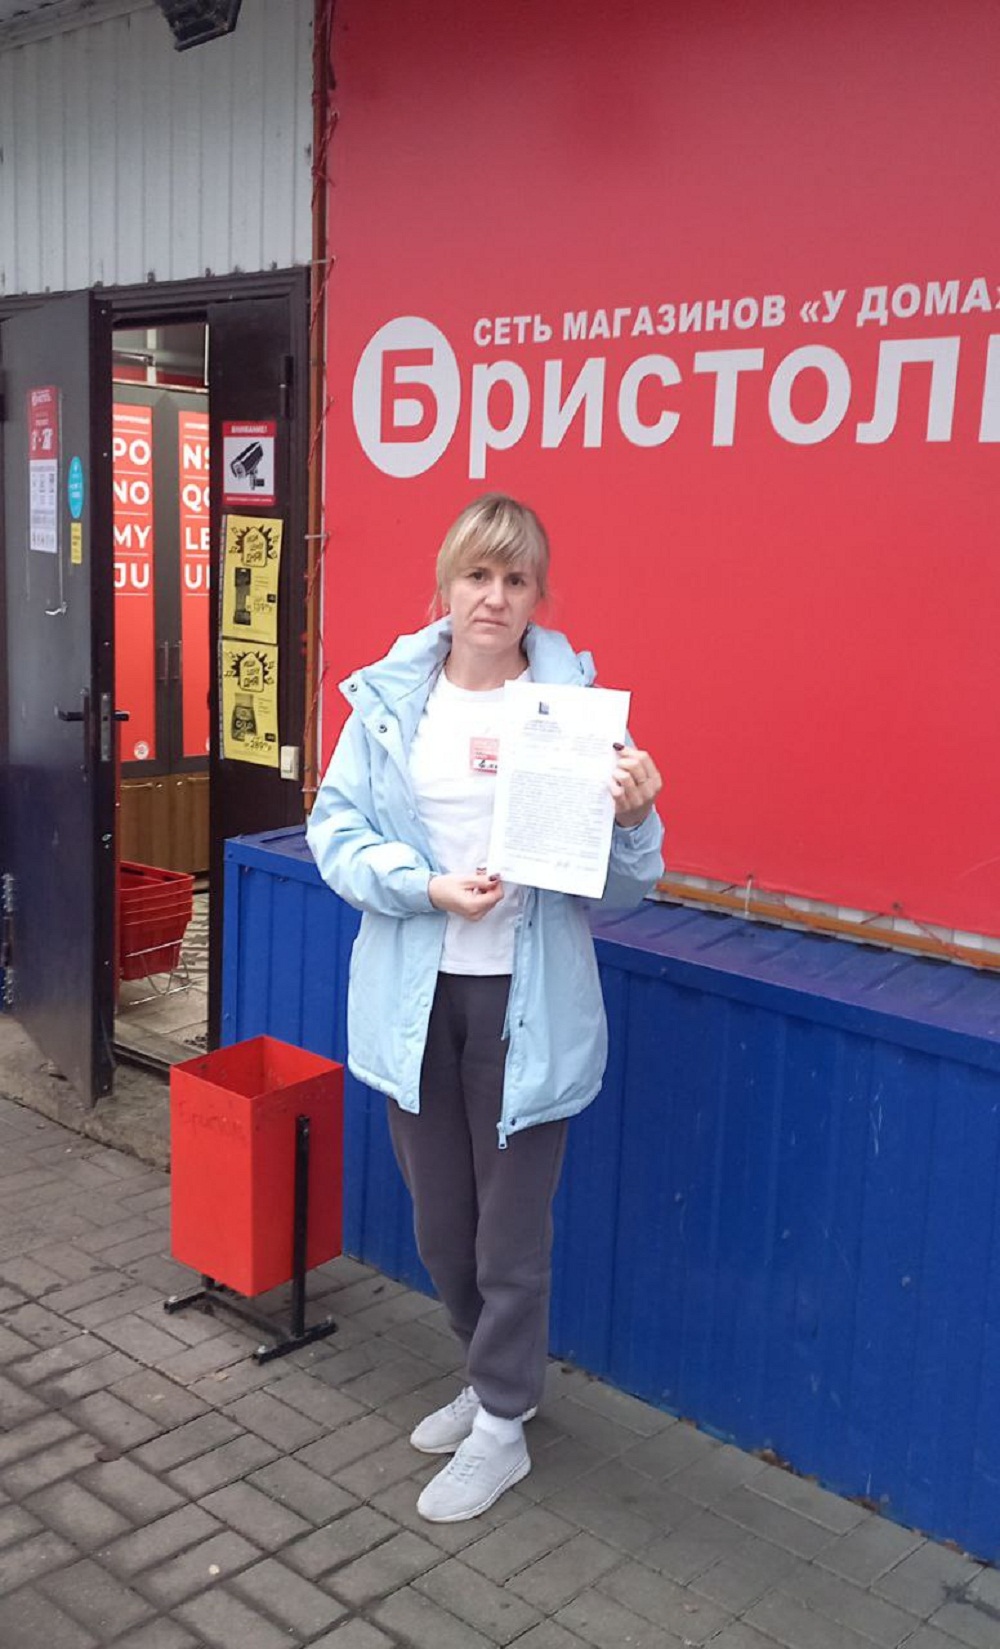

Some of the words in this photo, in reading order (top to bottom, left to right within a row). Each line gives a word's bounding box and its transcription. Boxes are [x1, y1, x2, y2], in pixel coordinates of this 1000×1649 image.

[473, 314, 553, 346] СЕТЬ
[563, 295, 786, 341] МАГАЗИНОВ
[800, 289, 846, 323] «У
[856, 278, 1000, 327] ДОМА
